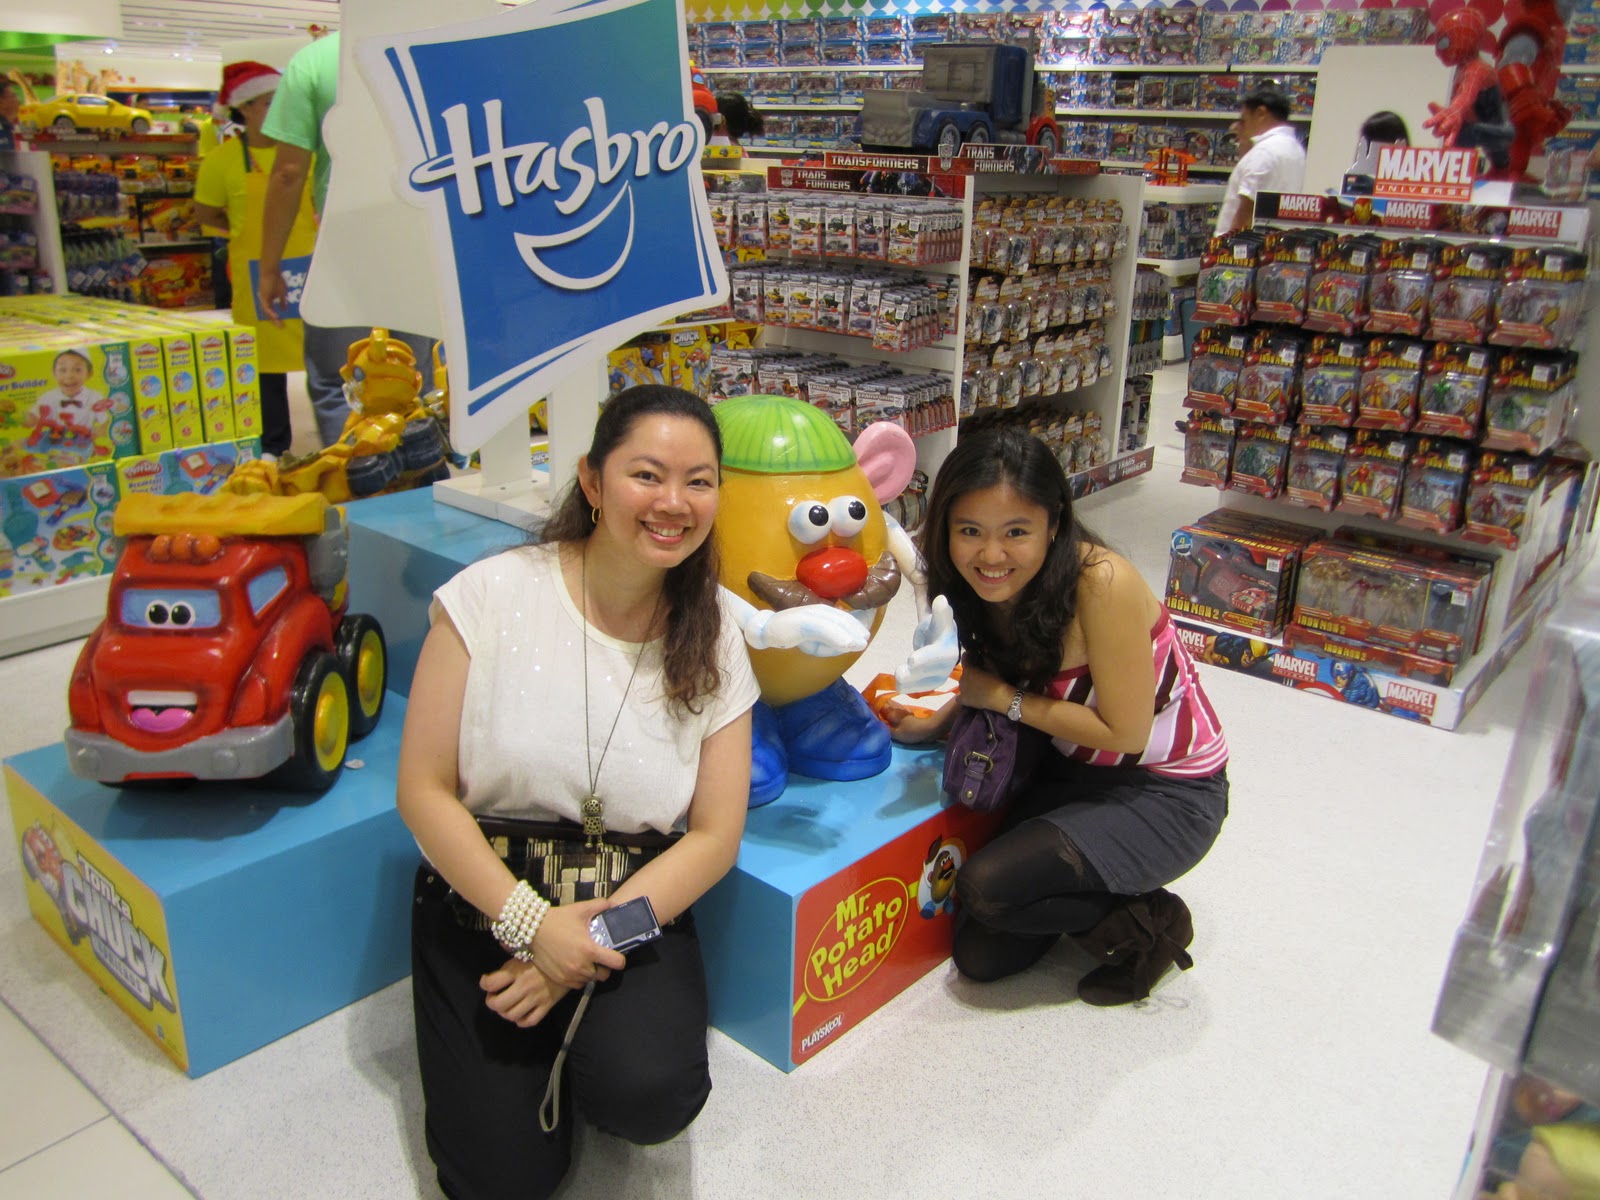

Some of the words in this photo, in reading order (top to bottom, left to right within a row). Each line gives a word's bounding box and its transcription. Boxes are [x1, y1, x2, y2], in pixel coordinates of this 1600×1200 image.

[409, 97, 698, 215] Hasbro
[831, 155, 919, 170] TRANSFORMERS
[966, 146, 994, 159] TRANS
[797, 169, 827, 180] TRANS
[973, 160, 1015, 173] FORMERS
[1379, 148, 1472, 184] MARVEL
[805, 179, 850, 190] FORMERS
[1375, 184, 1470, 197] UNIVERSE
[1279, 195, 1321, 212] MARVEL
[1385, 201, 1431, 220] MARVEL
[1509, 209, 1558, 228] MARVEL
[673, 330, 700, 343] CHUCK
[1167, 597, 1190, 613] IRON
[1191, 602, 1212, 617] MAN
[1213, 608, 1220, 620] 2
[1298, 615, 1318, 628] IRON
[1319, 619, 1340, 633] MAN
[1340, 625, 1346, 635] 2
[1177, 628, 1205, 648] ARVEL
[1324, 643, 1343, 655] IRON
[1344, 647, 1360, 659] MAN
[1360, 652, 1367, 661] 2
[1274, 653, 1316, 677] MARVEL
[1388, 683, 1434, 708] MARVEL
[77, 850, 132, 922] Tonka
[835, 893, 871, 933] Mr.
[62, 861, 175, 1012] CHUCK
[811, 897, 903, 978] Potato
[822, 921, 895, 998] Head
[801, 1014, 843, 1051] PLAYSKOOL
